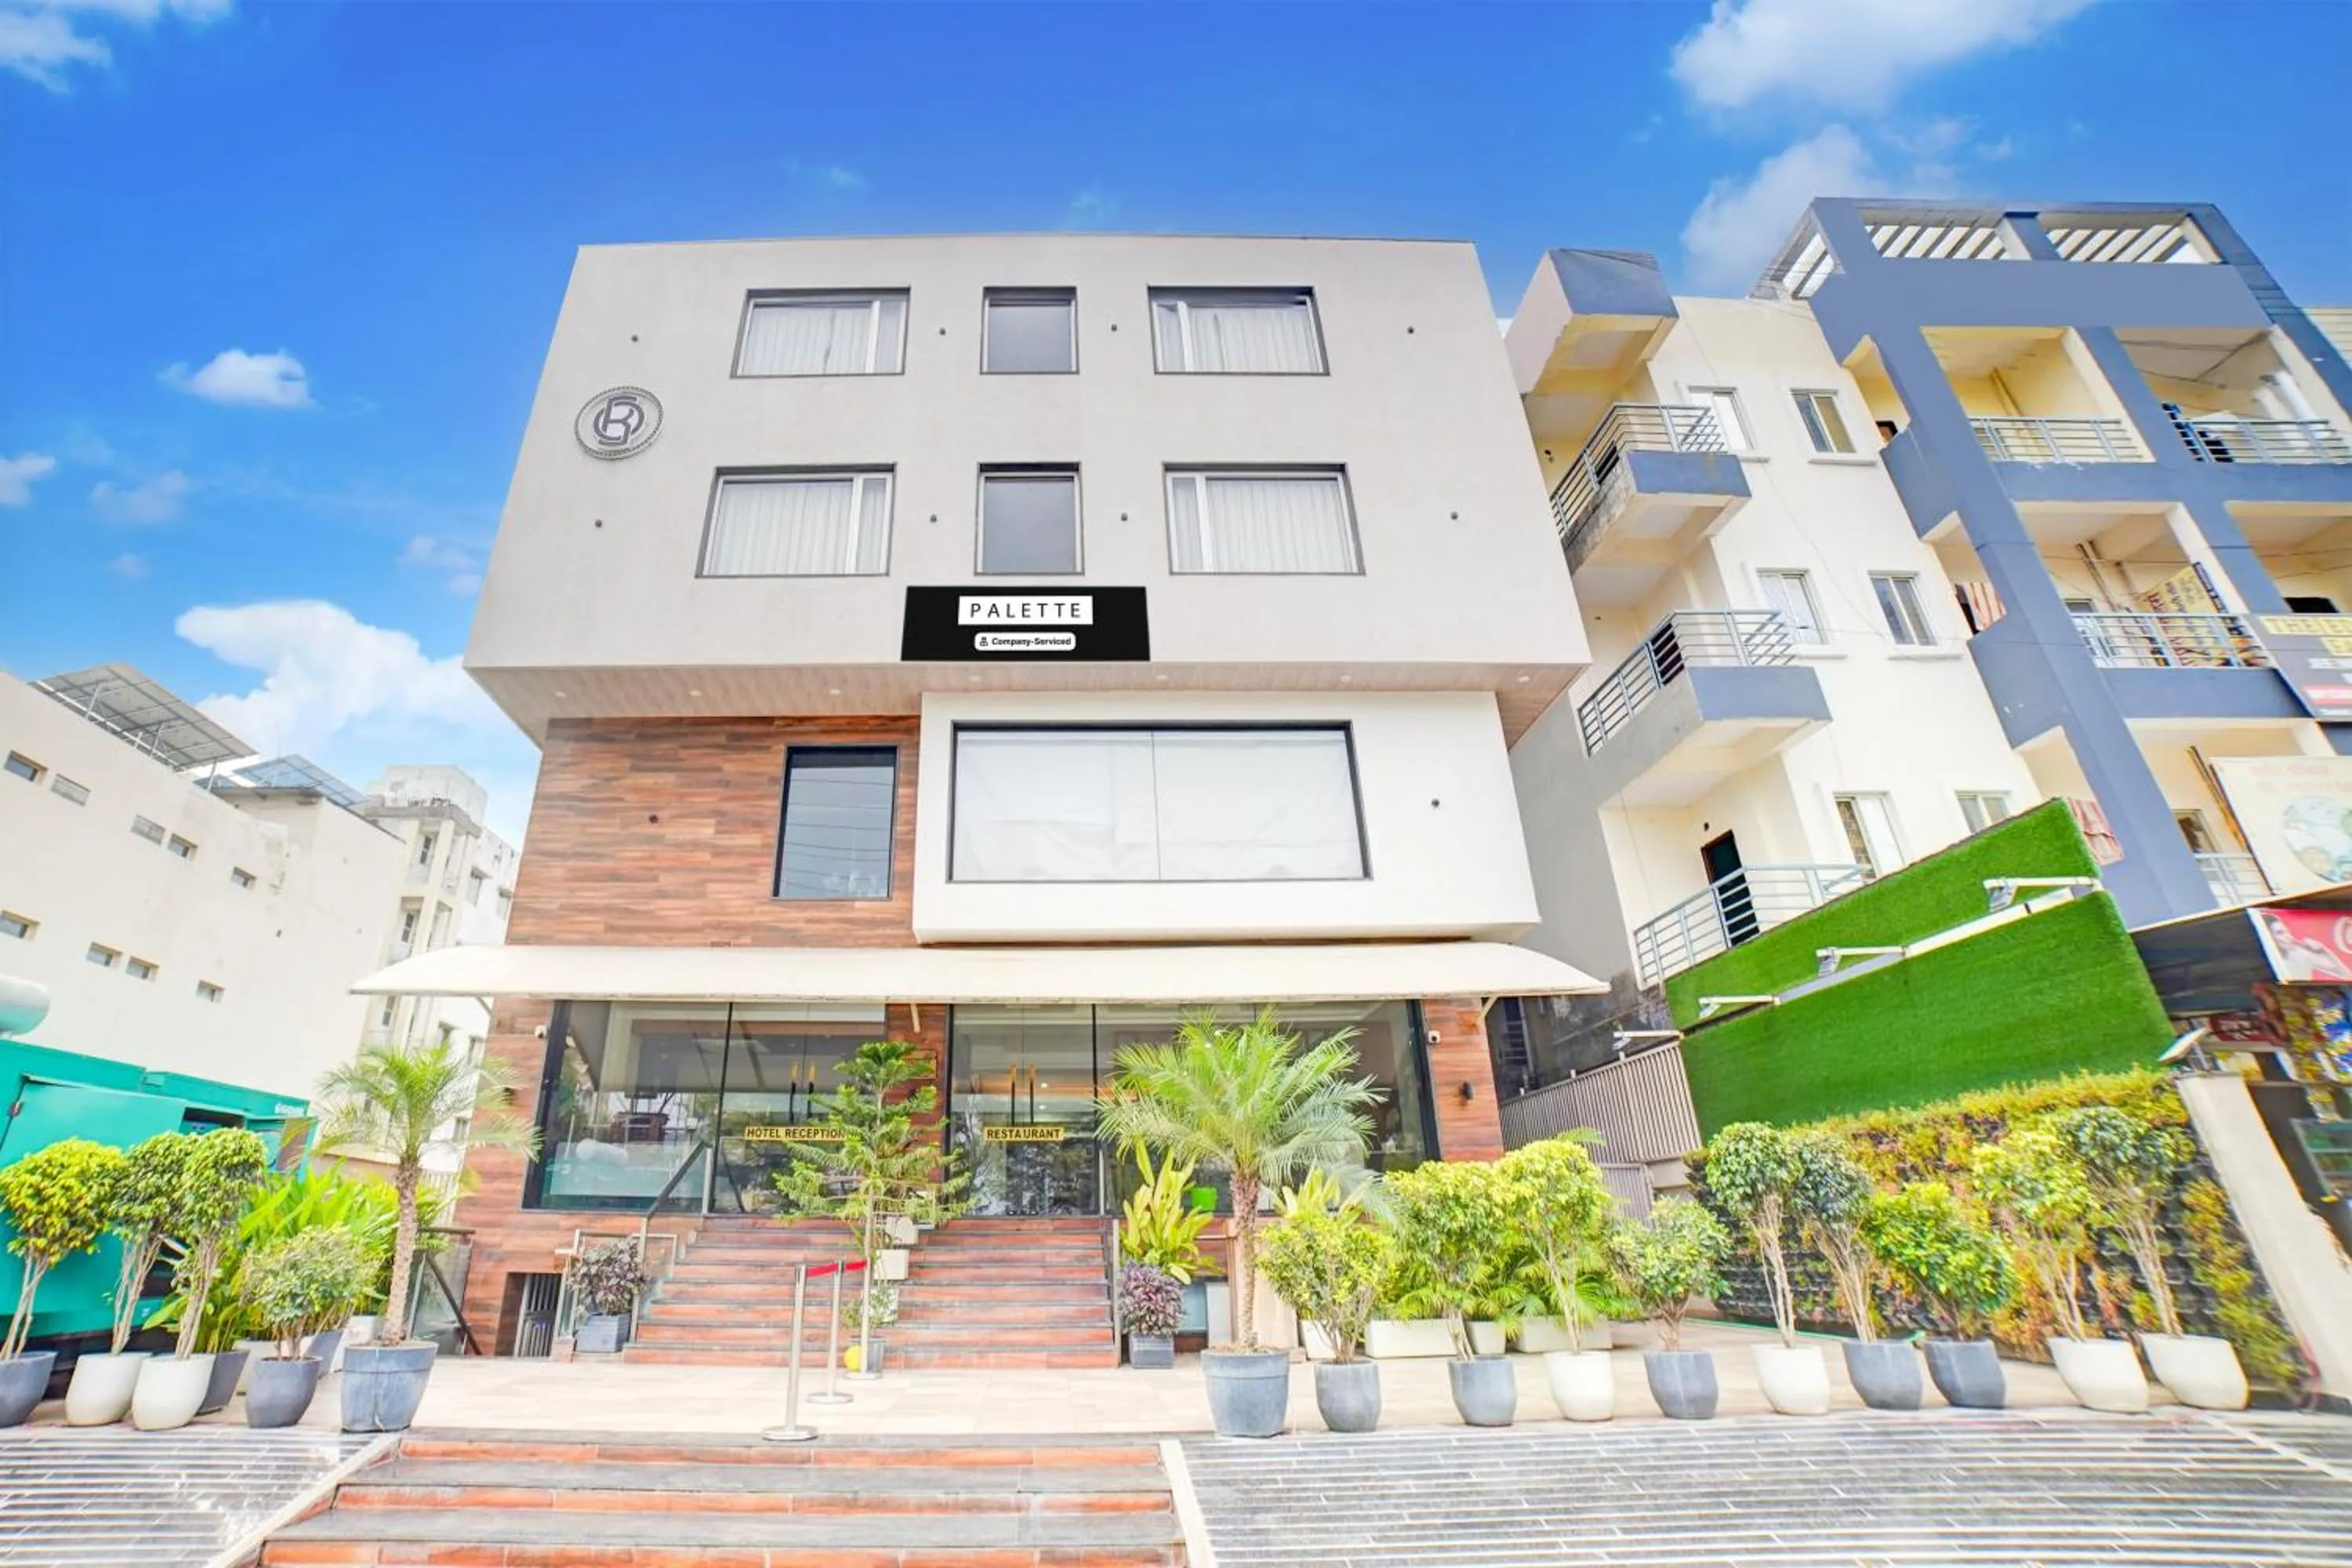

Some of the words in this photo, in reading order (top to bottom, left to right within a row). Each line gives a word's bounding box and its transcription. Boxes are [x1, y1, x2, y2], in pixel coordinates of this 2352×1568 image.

[970, 603, 1081, 619] PALETTE
[991, 636, 1072, 647] Company-Serviced
[746, 1128, 782, 1138] HOTEL
[785, 1128, 846, 1139] RECEPTION
[987, 1128, 1062, 1139] RESTAURANT
